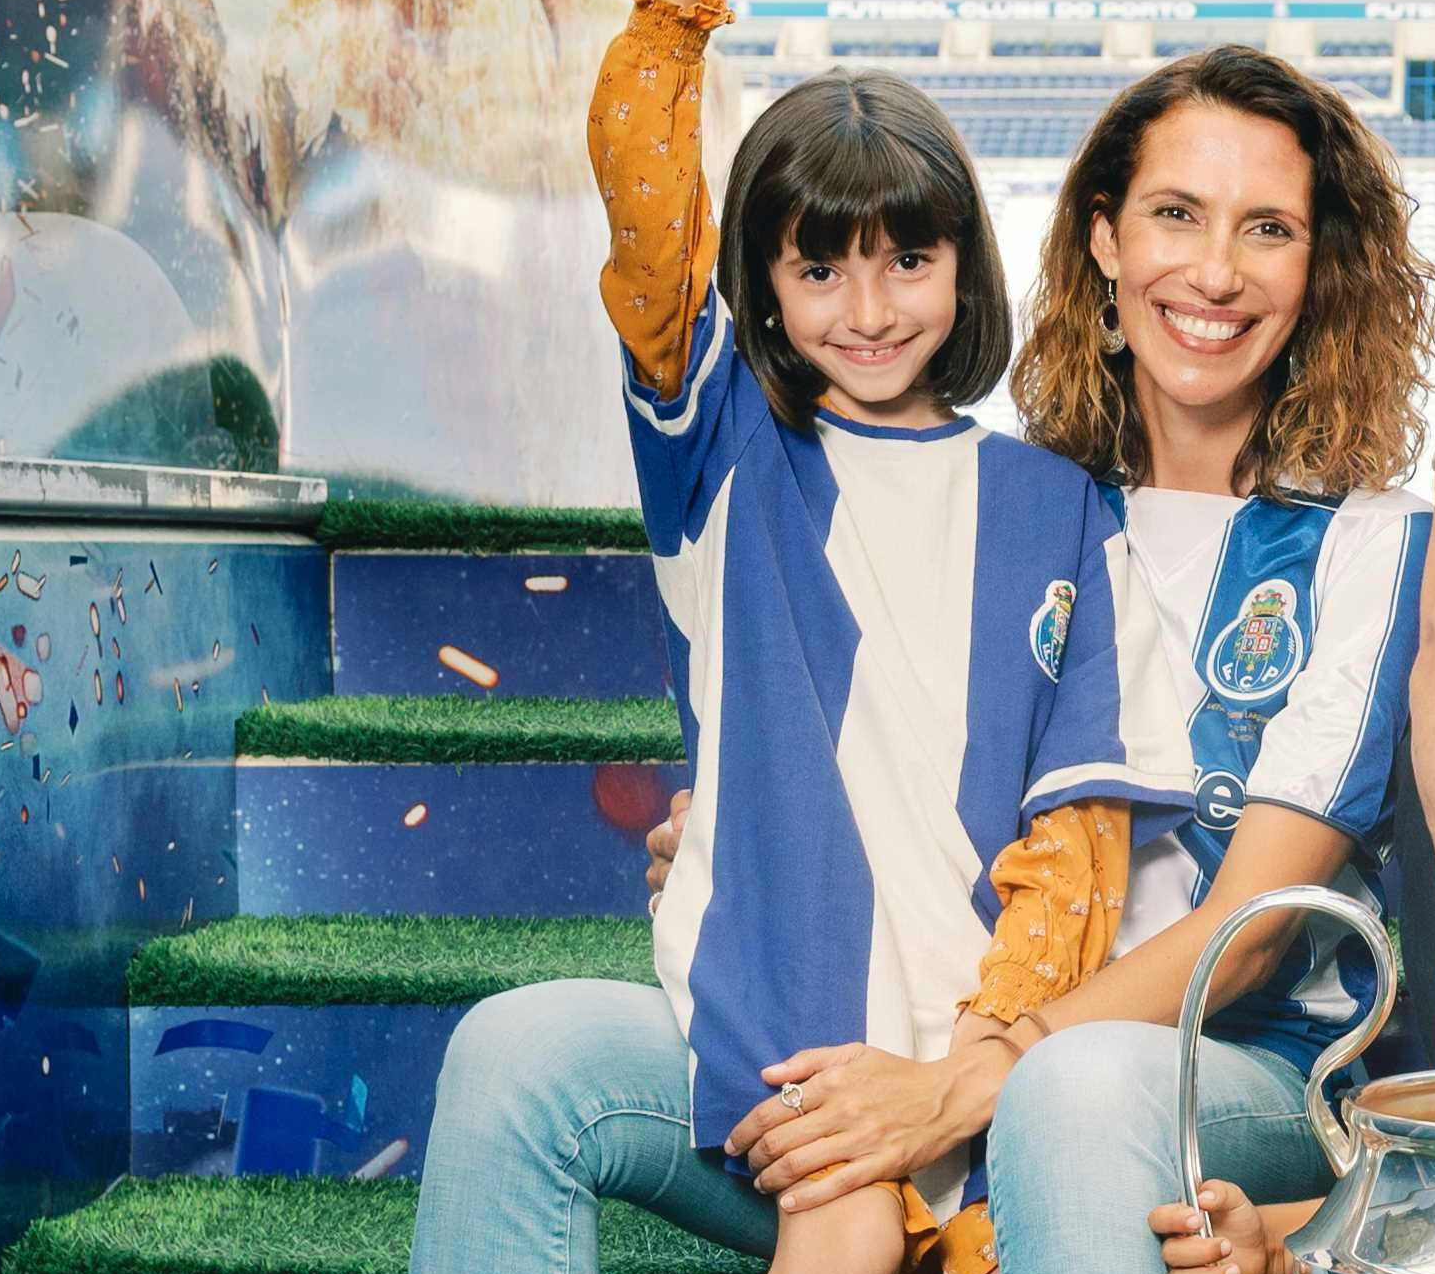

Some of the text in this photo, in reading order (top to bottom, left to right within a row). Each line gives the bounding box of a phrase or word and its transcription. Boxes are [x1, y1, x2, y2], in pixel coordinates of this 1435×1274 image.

[828, 0, 956, 20] FUTEBOL
[1056, 0, 1096, 20] DO
[1100, 0, 1195, 20] PORTO
